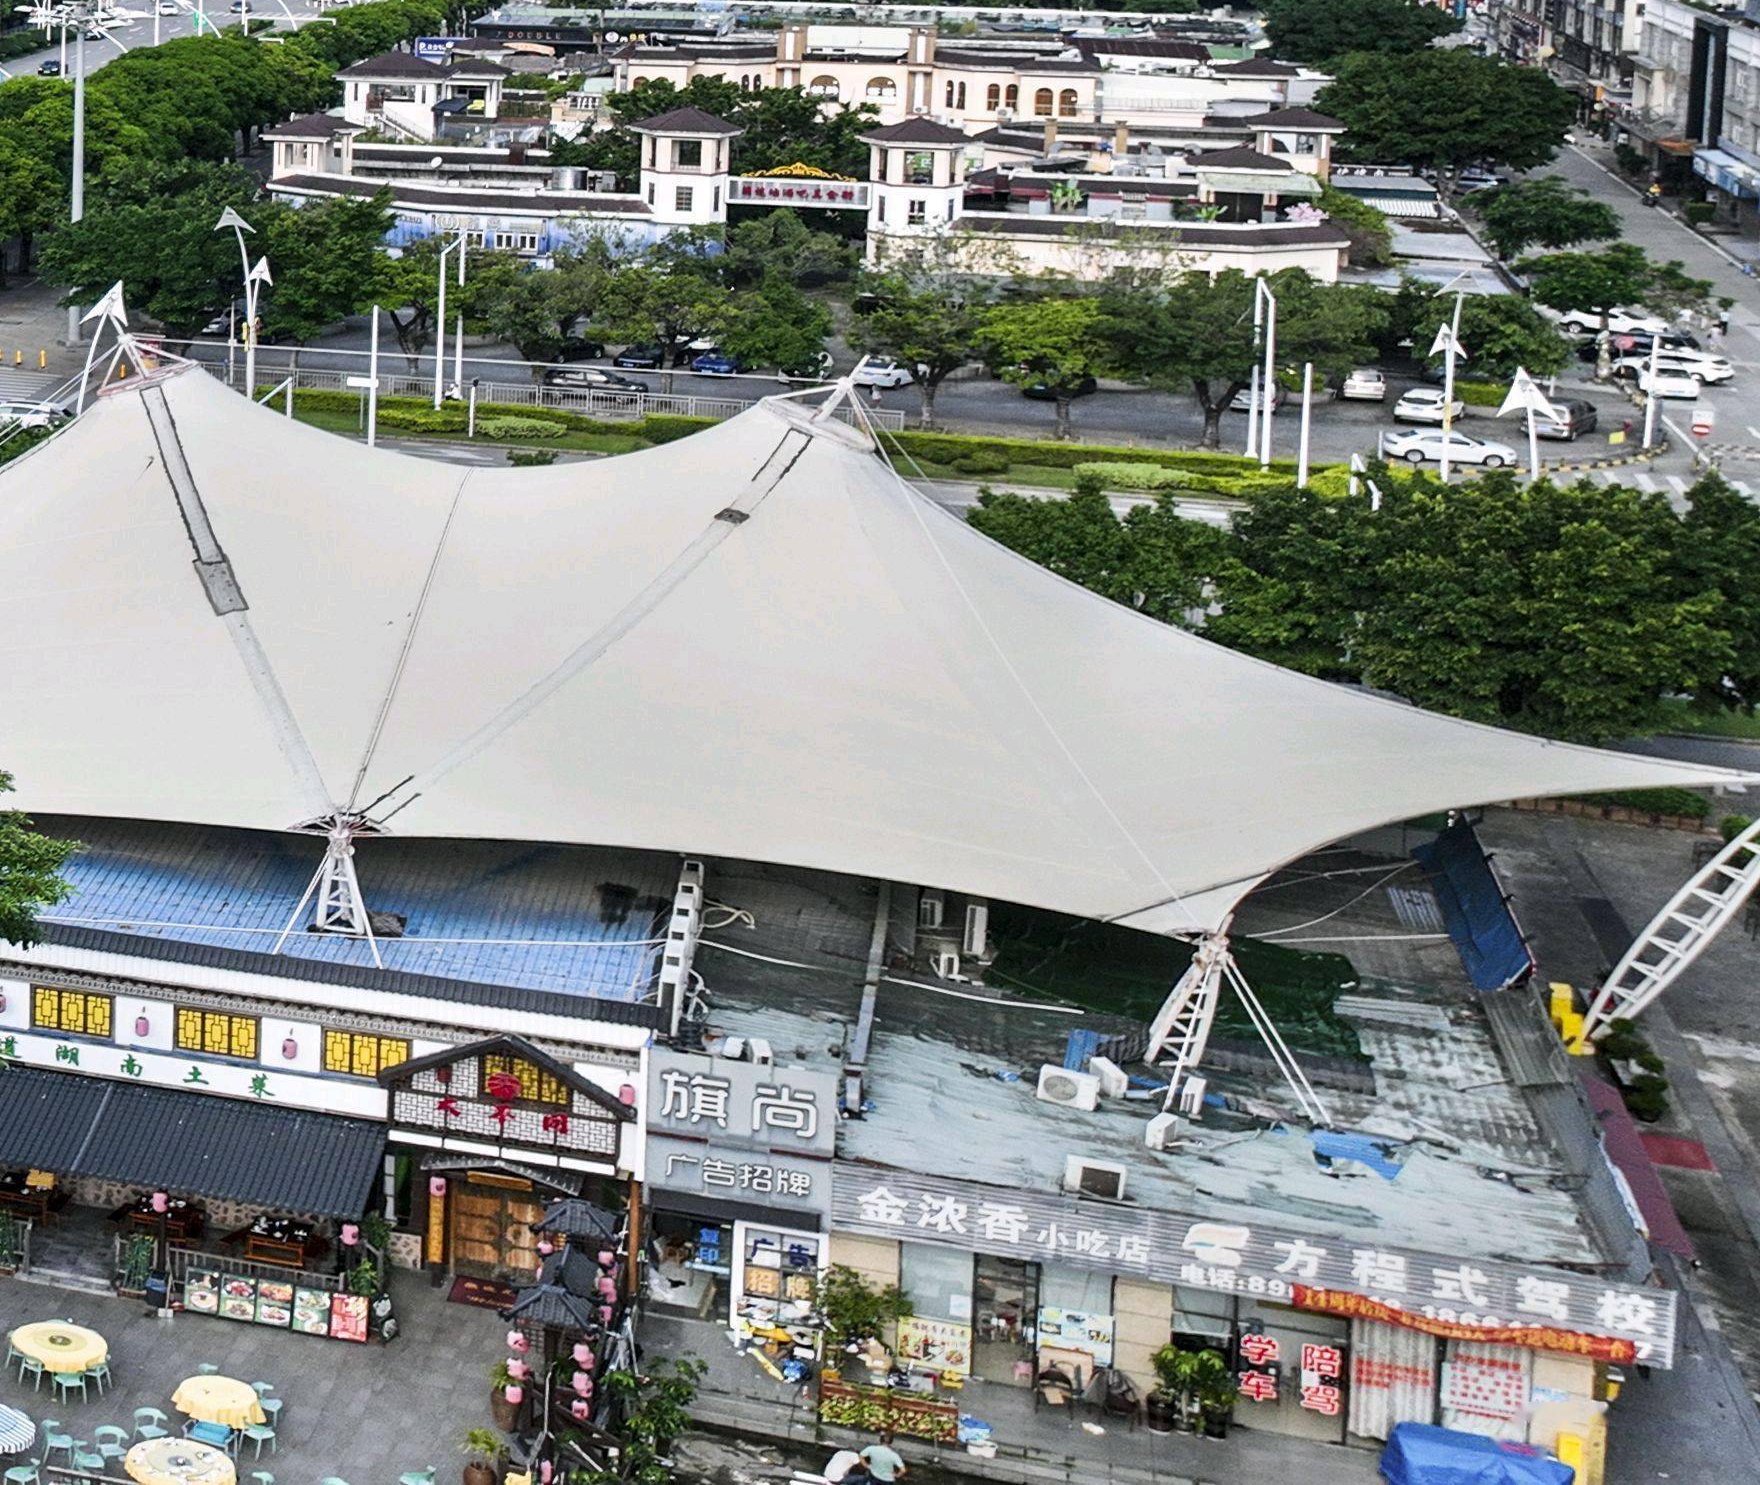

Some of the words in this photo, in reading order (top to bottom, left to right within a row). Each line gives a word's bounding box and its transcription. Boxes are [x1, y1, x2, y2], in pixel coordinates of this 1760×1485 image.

[661, 1070, 818, 1139] 旗尚
[665, 1154, 812, 1198] 广告招牌
[750, 1238, 810, 1267] 广告
[857, 1185, 1030, 1244] 金浓香
[1036, 1223, 1151, 1264] 小吃店
[1273, 1239, 1657, 1335] 方程式驾校
[1238, 1333, 1279, 1401] 学车
[1300, 1342, 1341, 1415] 陪驾
